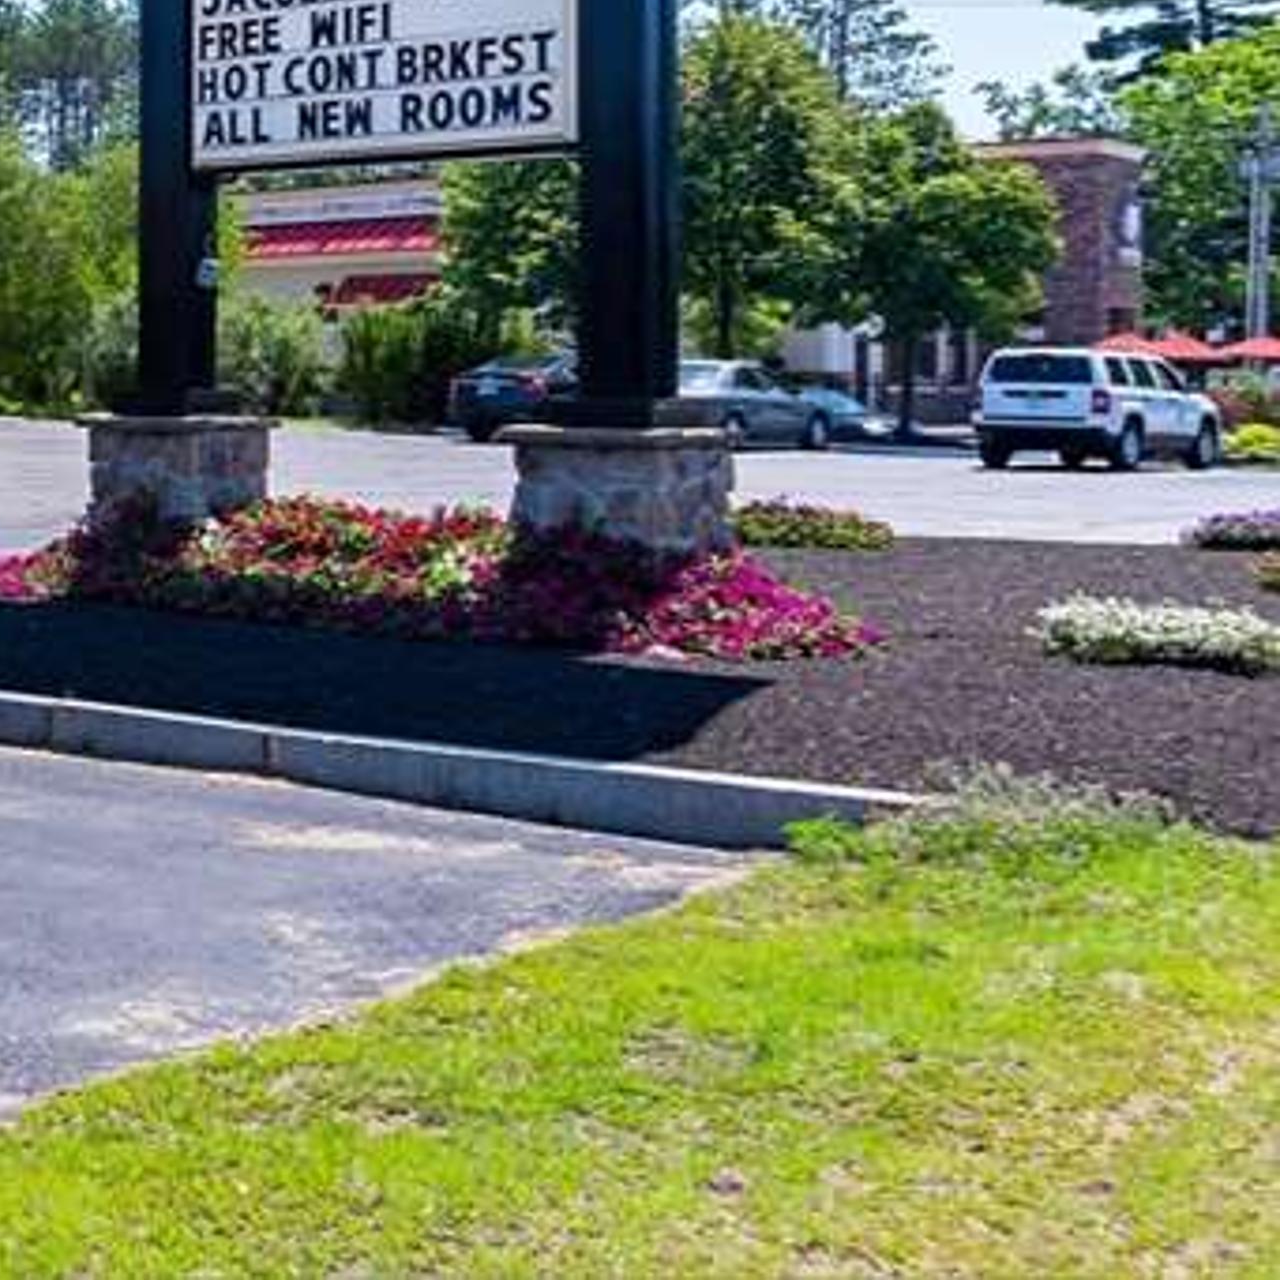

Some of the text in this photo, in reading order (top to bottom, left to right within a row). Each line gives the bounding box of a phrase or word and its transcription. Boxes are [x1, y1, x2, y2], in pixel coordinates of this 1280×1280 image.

[198, 2, 392, 61] FREE WIFI
[198, 30, 556, 106] HOT CONT BRKFST
[203, 81, 553, 148] ALL NEW ROOMS
